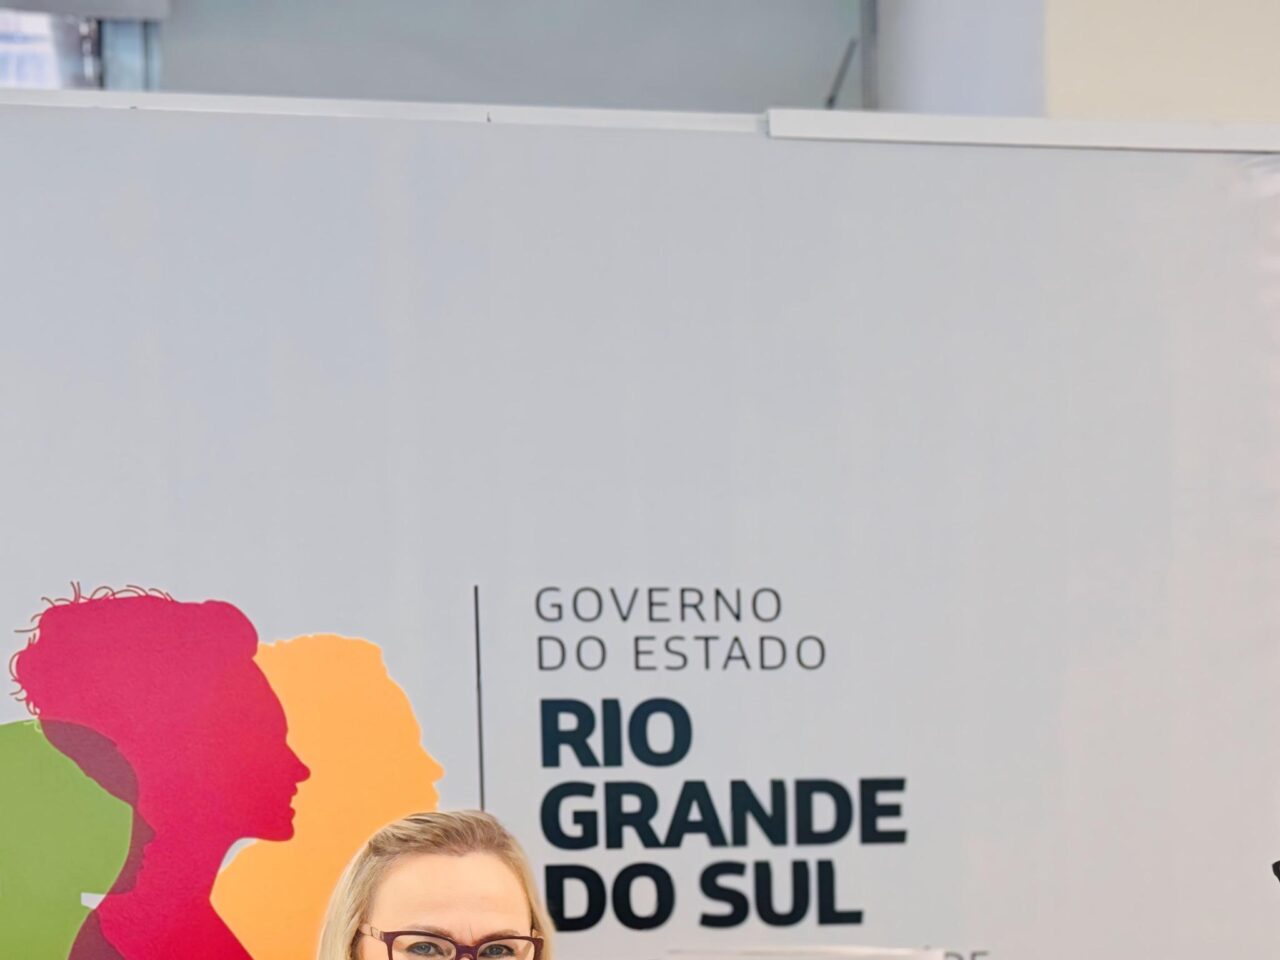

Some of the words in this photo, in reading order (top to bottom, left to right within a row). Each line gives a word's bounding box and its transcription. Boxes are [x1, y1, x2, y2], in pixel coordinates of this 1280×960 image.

[535, 586, 783, 622] GOVERNO
[537, 635, 607, 670] DO
[634, 635, 826, 670] ESTADO
[540, 698, 692, 767] RIO
[540, 777, 907, 850] GRANDE
[544, 862, 675, 933] DO
[699, 859, 863, 928] SUL
